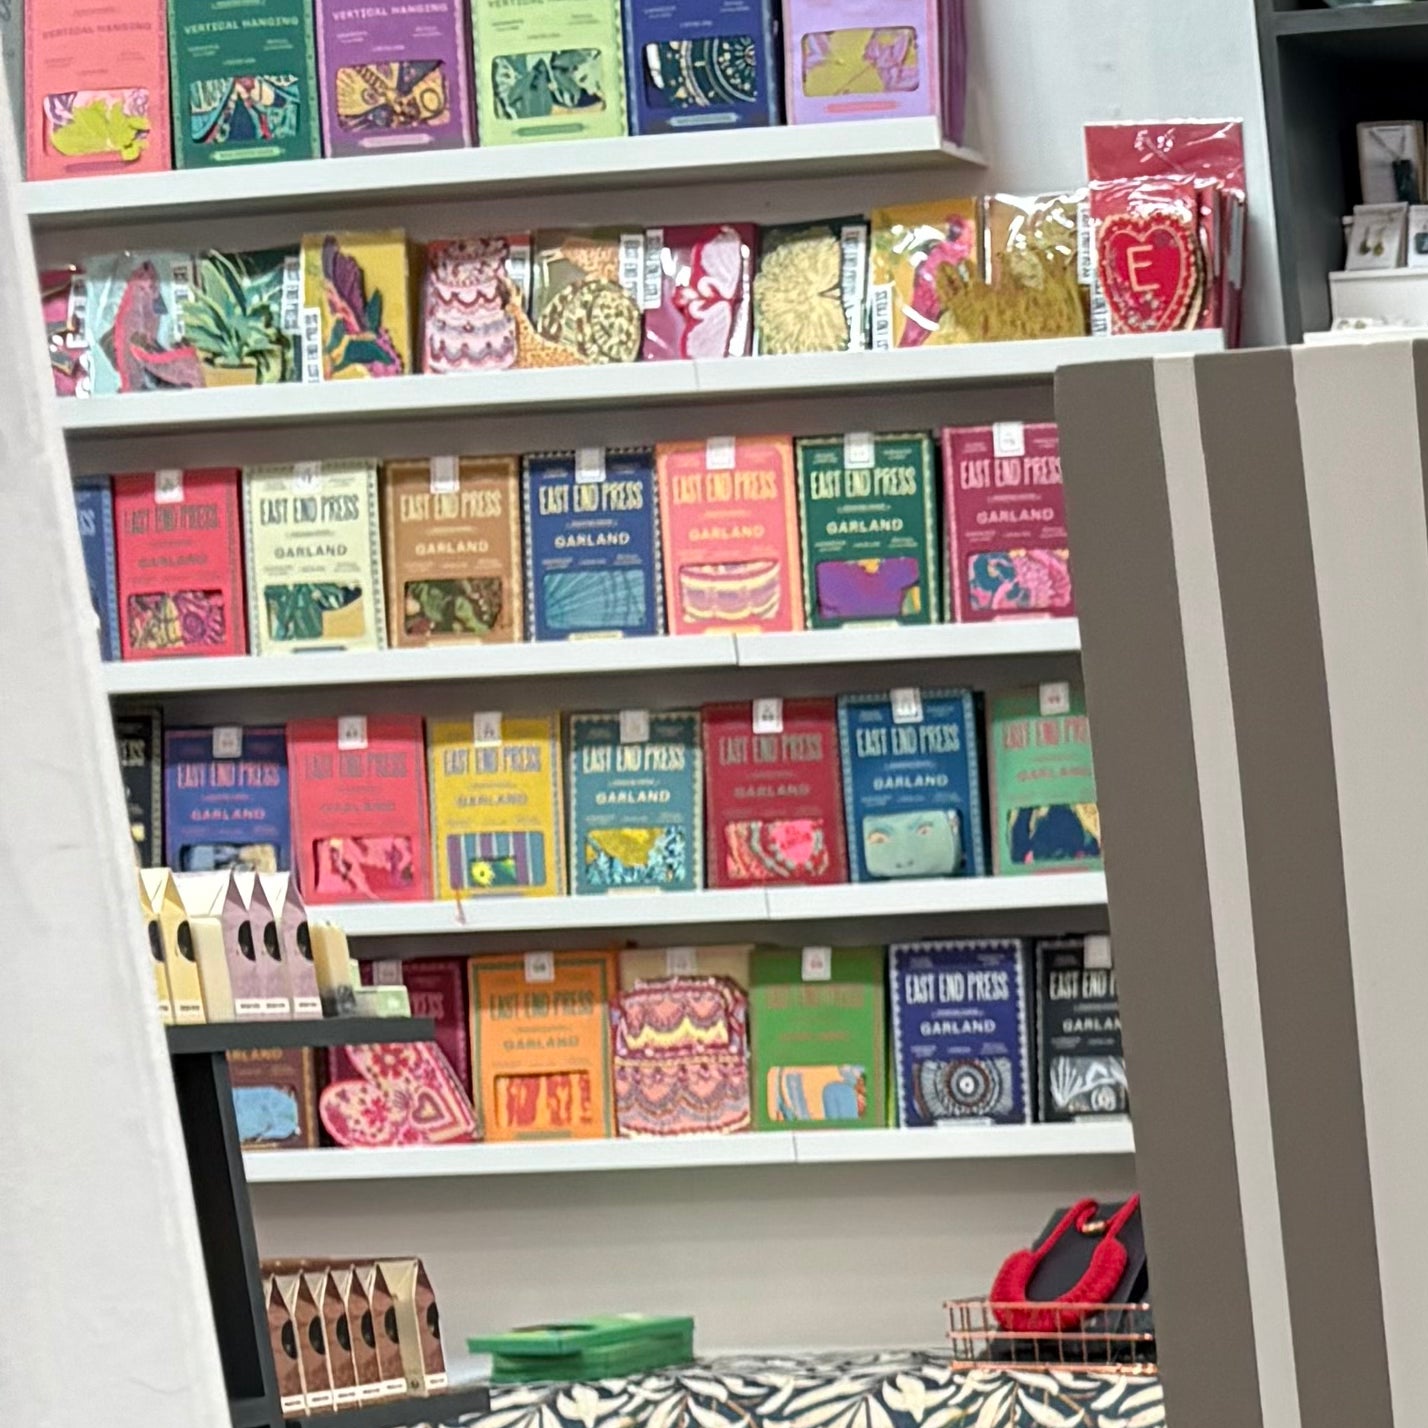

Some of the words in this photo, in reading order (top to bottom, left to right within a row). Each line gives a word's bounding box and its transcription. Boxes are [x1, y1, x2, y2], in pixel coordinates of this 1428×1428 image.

[183, 21, 239, 35] VERTICAL
[241, 17, 300, 30] HANGING
[332, 8, 388, 21] VERTICAL
[391, 4, 449, 15] HANGING
[810, 471, 842, 500] EAST
[845, 469, 871, 498] END
[874, 467, 917, 496] PRESS
[959, 460, 990, 489] EAST
[994, 458, 1022, 487] END
[1023, 456, 1064, 485] PRESS
[539, 485, 569, 515] EAST
[573, 483, 599, 513] END
[601, 481, 644, 512] PRESS
[673, 474, 701, 504] EAST
[706, 473, 732, 501] END
[735, 471, 778, 500] PRESS
[260, 498, 289, 526] EAST
[293, 496, 318, 524] END
[320, 494, 360, 523] PRESS
[400, 494, 429, 523] EAST
[434, 492, 459, 520] END
[460, 490, 502, 519] PRESS
[976, 508, 1055, 525] GARLAND
[554, 532, 631, 549] GARLAND
[688, 525, 765, 541] GARLAND
[827, 519, 904, 535] GARLAND
[274, 544, 348, 559] GARLAND
[415, 540, 489, 556] GARLAND
[856, 727, 887, 758] EAST
[891, 725, 918, 755] END
[919, 724, 960, 753] PRESS
[1063, 717, 1090, 744] PRE
[582, 748, 612, 774] EAST
[616, 745, 642, 772] END
[644, 744, 685, 772] PRESS
[719, 736, 747, 766] EAST
[752, 735, 779, 762] END
[781, 734, 823, 762] PRESS
[177, 764, 204, 789] EAST
[210, 762, 236, 787] END
[238, 762, 280, 787] PRESS
[873, 774, 949, 791] GARLAND
[595, 790, 670, 806] GARLAND
[905, 974, 935, 1004] EAST
[939, 972, 965, 1002] END
[967, 971, 1009, 1001] PRESS
[1049, 972, 1078, 1000] EAST
[1082, 971, 1107, 998] END
[919, 1019, 996, 1036] GARLAND
